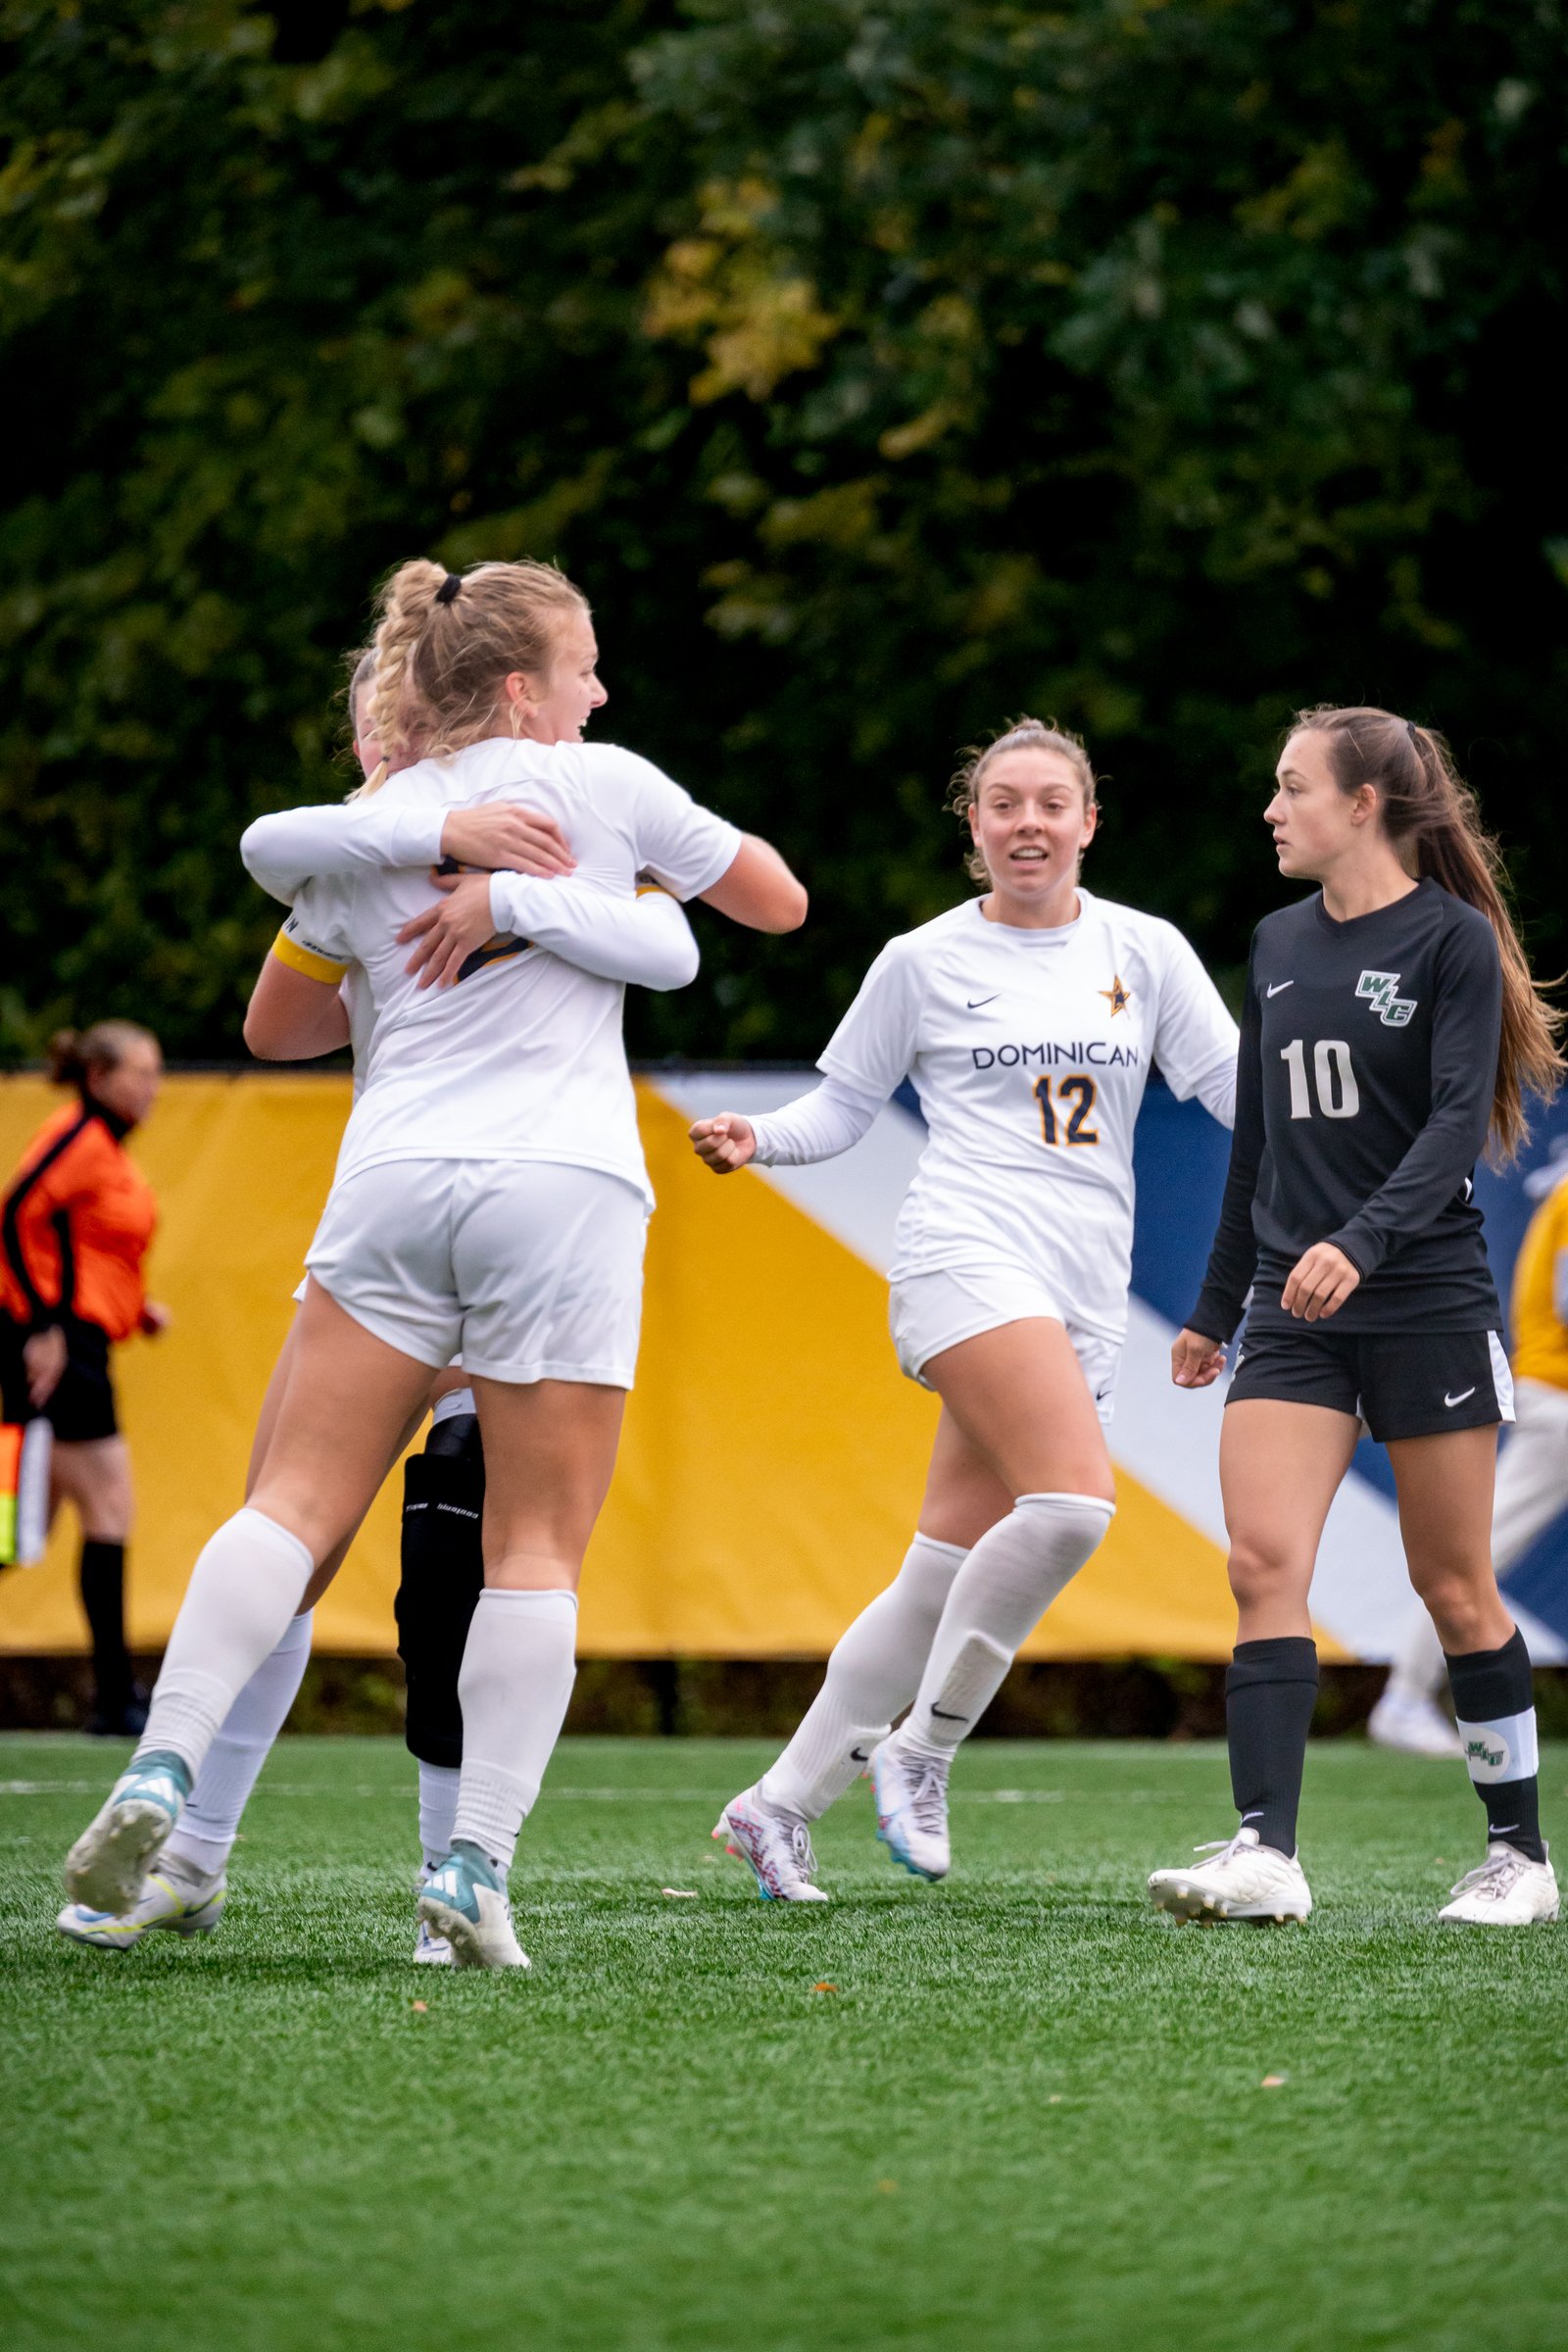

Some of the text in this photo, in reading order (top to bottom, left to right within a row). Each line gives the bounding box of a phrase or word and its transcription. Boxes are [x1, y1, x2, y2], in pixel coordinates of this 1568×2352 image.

[1355, 970, 1418, 1027] WLC
[971, 1042, 1139, 1070] DOMINICAN
[1280, 1039, 1360, 1119] 10
[1033, 1073, 1100, 1147] 12
